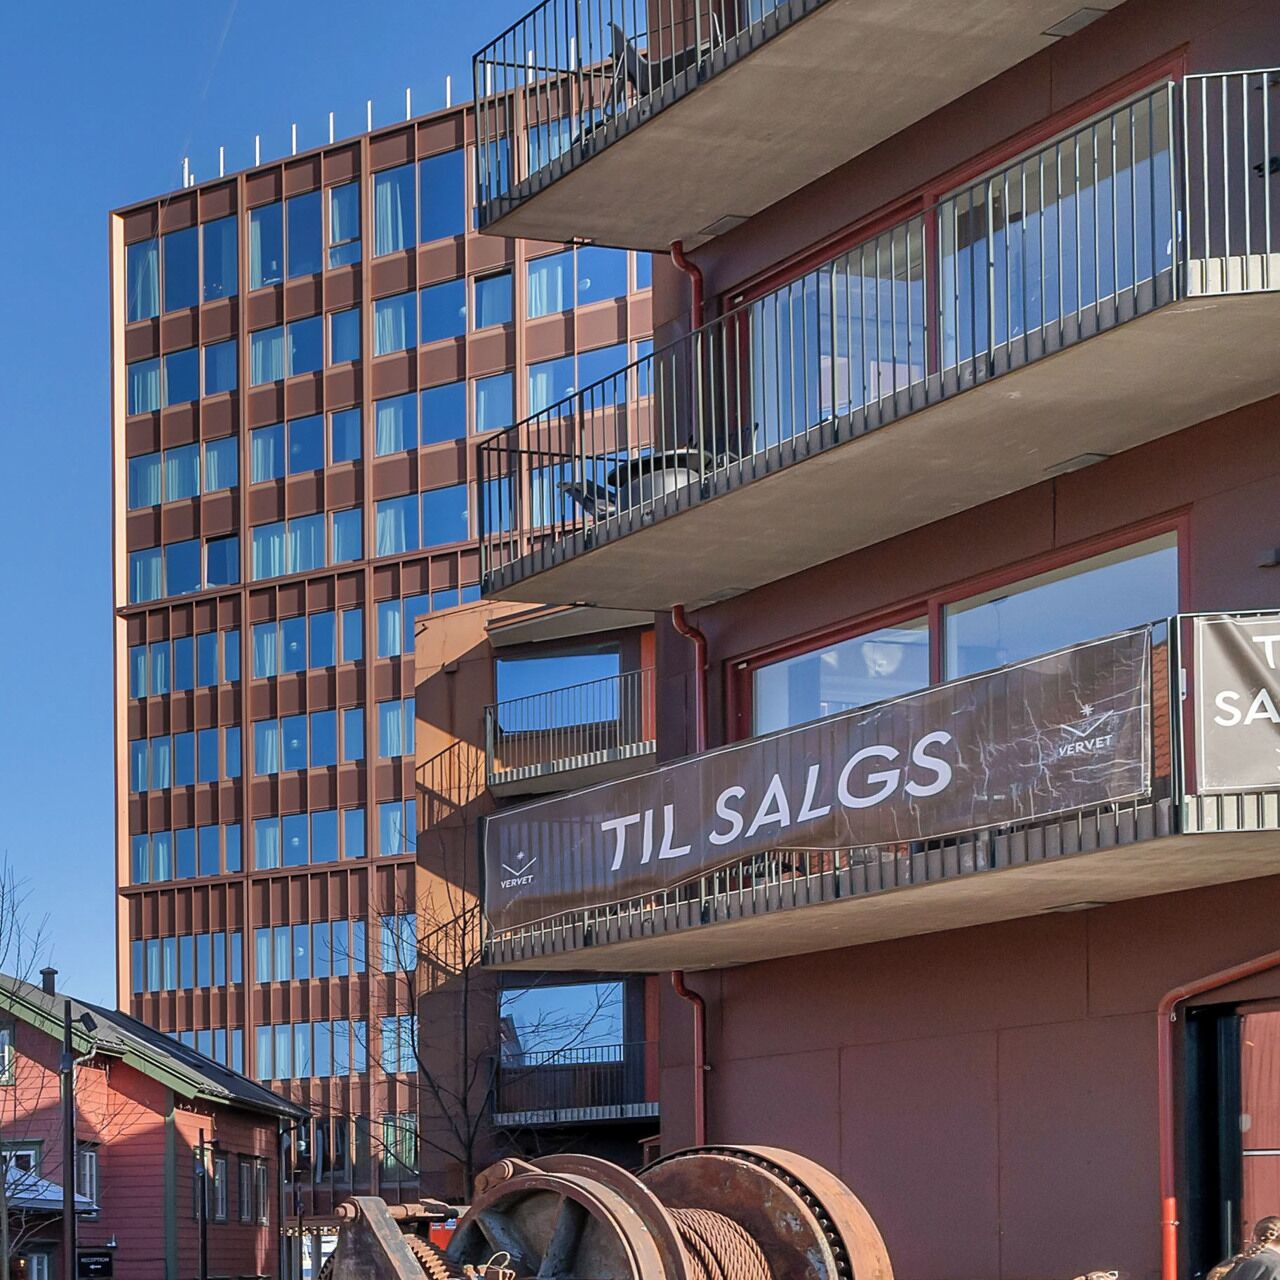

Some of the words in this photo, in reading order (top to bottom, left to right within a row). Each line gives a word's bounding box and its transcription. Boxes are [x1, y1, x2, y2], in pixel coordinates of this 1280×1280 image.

[1059, 734, 1113, 757] VERVET
[600, 803, 692, 872] TIL
[708, 730, 953, 846] SALGS
[500, 874, 534, 889] VERVET
